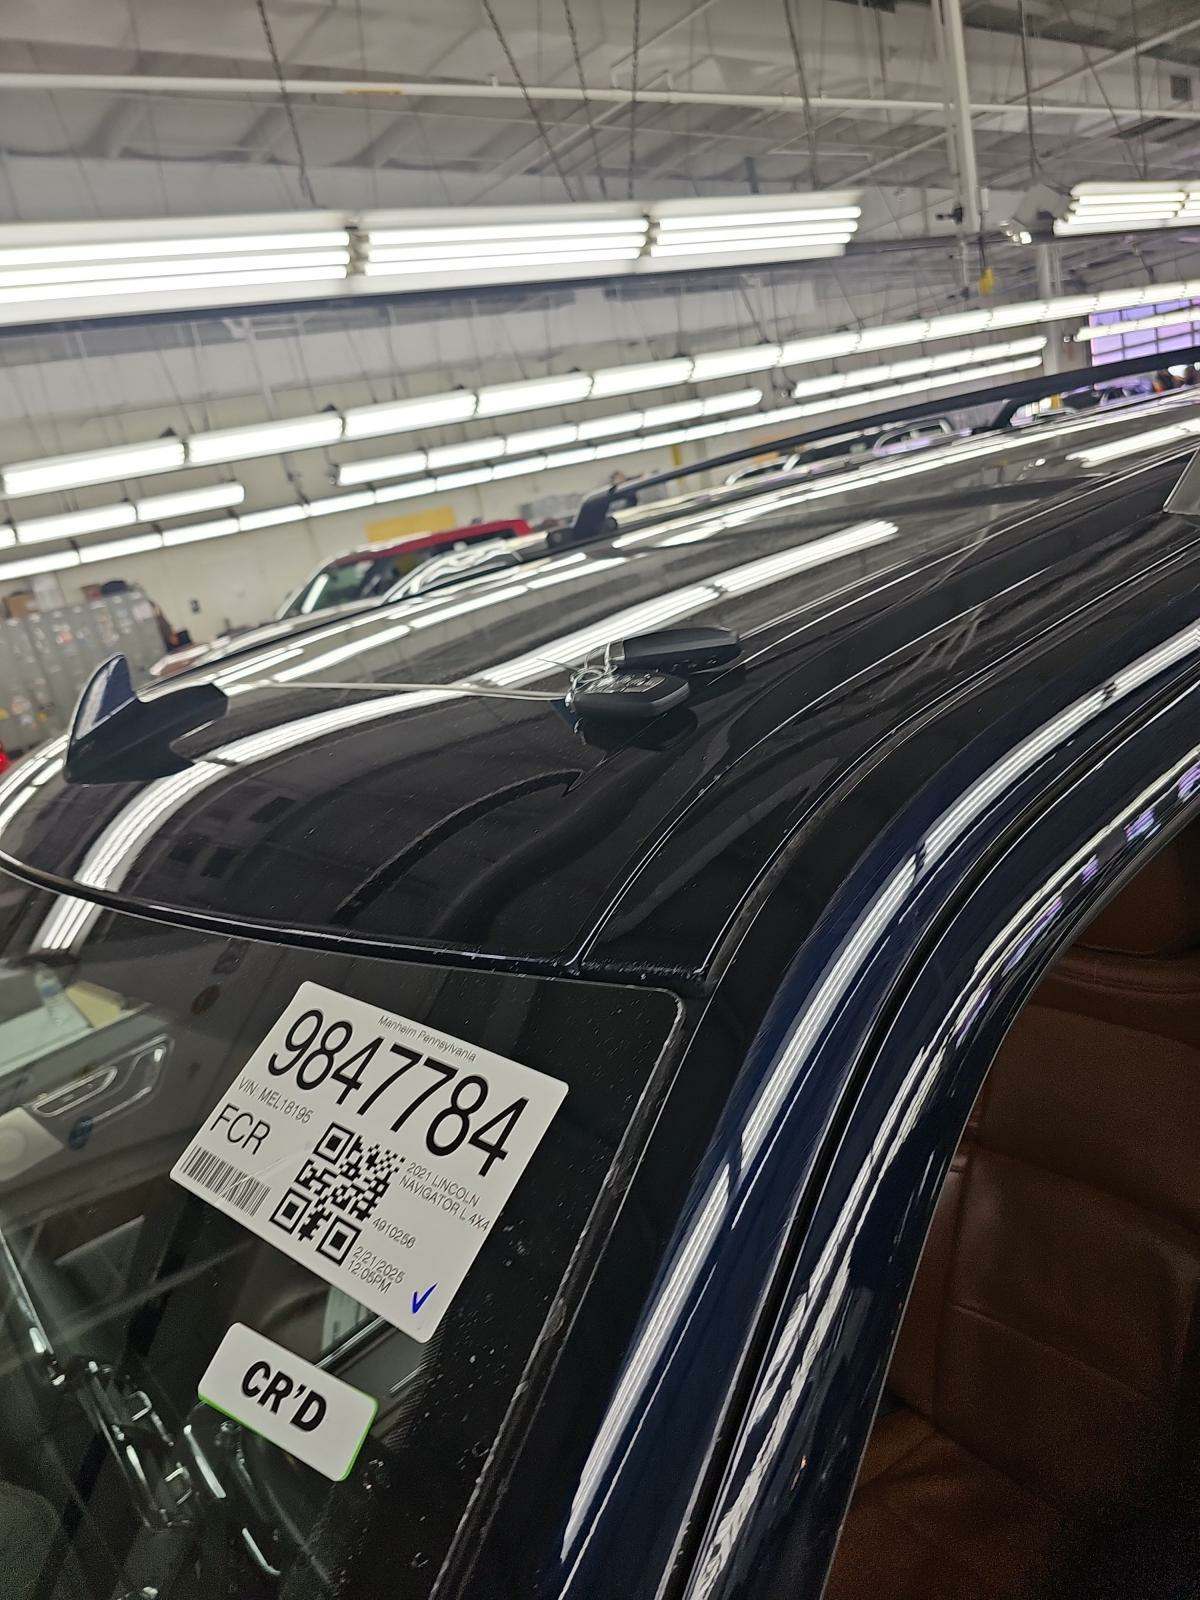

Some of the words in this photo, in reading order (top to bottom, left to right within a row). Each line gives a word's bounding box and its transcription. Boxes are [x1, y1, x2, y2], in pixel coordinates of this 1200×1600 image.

[416, 1030, 476, 1062] Pennsylvania
[268, 1009, 529, 1177] 9847784
[210, 1103, 270, 1155] FCR
[399, 1175, 460, 1216] NAVIGATOR
[467, 1213, 490, 1232] 4X4
[407, 1162, 433, 1182] 2021
[431, 1175, 480, 1208] LINCOLN
[242, 1361, 327, 1432] CR'D
